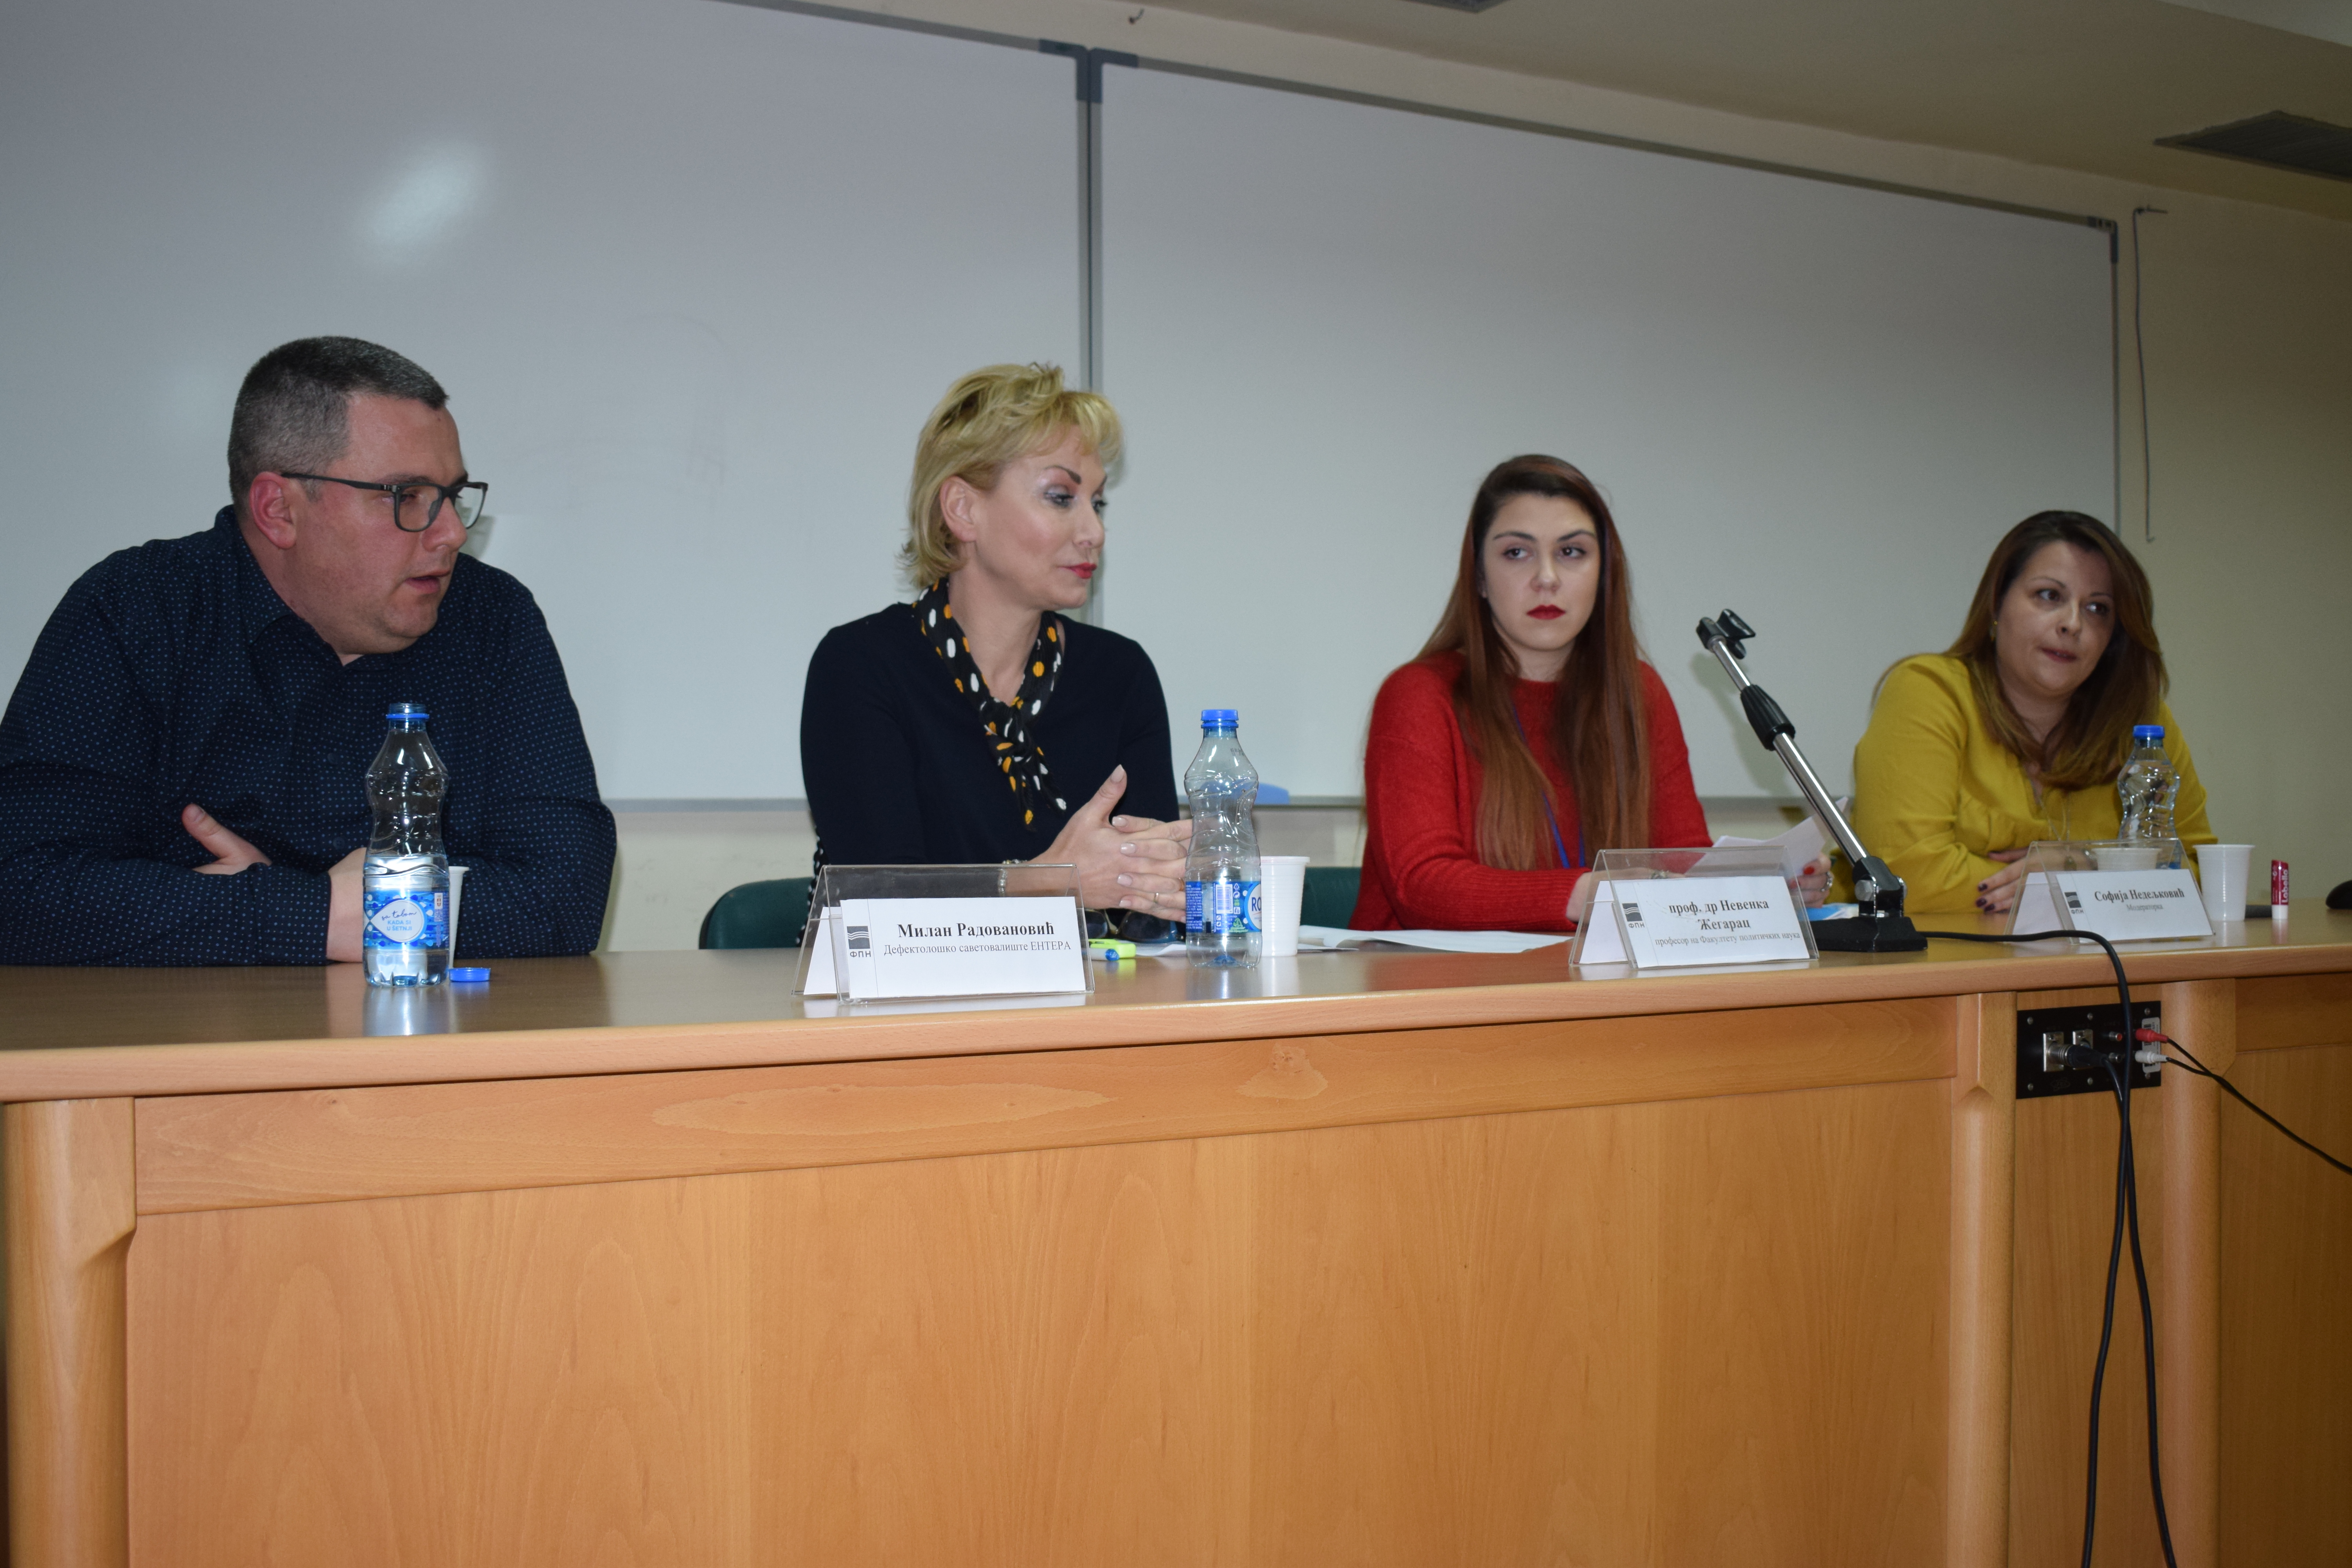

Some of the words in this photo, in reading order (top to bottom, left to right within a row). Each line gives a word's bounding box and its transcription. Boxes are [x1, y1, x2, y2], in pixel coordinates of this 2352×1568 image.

[2094, 890, 2128, 903] Софија
[2129, 888, 2185, 900] Недељковић
[1251, 897, 1261, 911] RO
[1669, 902, 1702, 915] проф.
[1705, 903, 1717, 915] др
[1719, 899, 1769, 911] Невенка
[897, 924, 953, 937] Милан
[956, 922, 1055, 938] Радовановић
[1698, 918, 1751, 931] Жегарац
[884, 944, 956, 956] Дефектолошко
[960, 943, 1028, 952] саветовалиште
[1031, 941, 1071, 950] ЕНТЕРА
[1655, 936, 1689, 947] професор
[1700, 935, 1737, 944] Факултету
